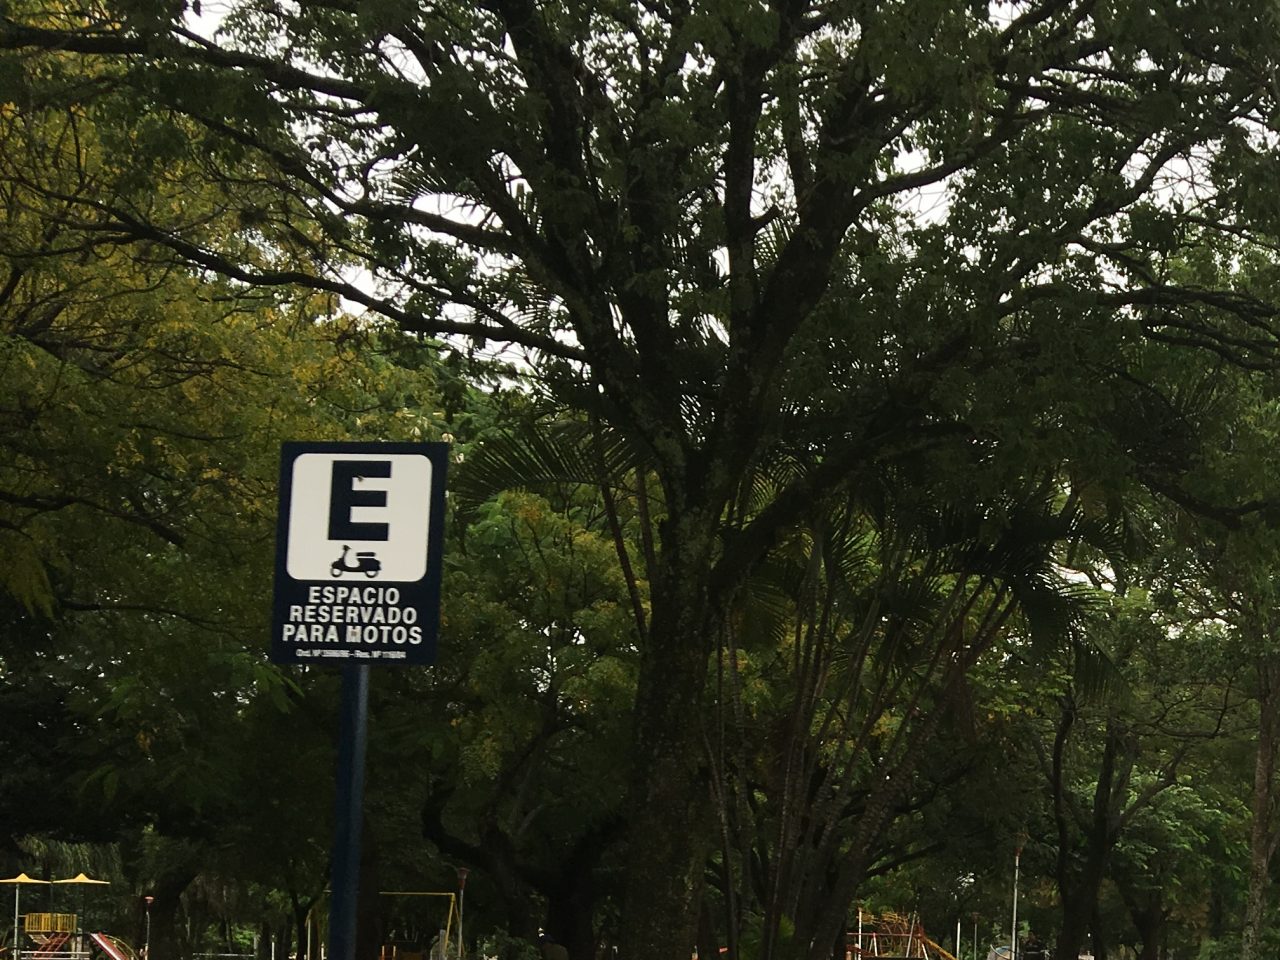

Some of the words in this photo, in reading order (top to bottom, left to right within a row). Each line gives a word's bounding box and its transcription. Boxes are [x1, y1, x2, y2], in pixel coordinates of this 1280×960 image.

[328, 460, 392, 541] E
[308, 586, 400, 605] ESPACIO
[289, 605, 417, 625] RESERVADO
[282, 624, 339, 642] PARA
[345, 625, 422, 644] MOTOS
